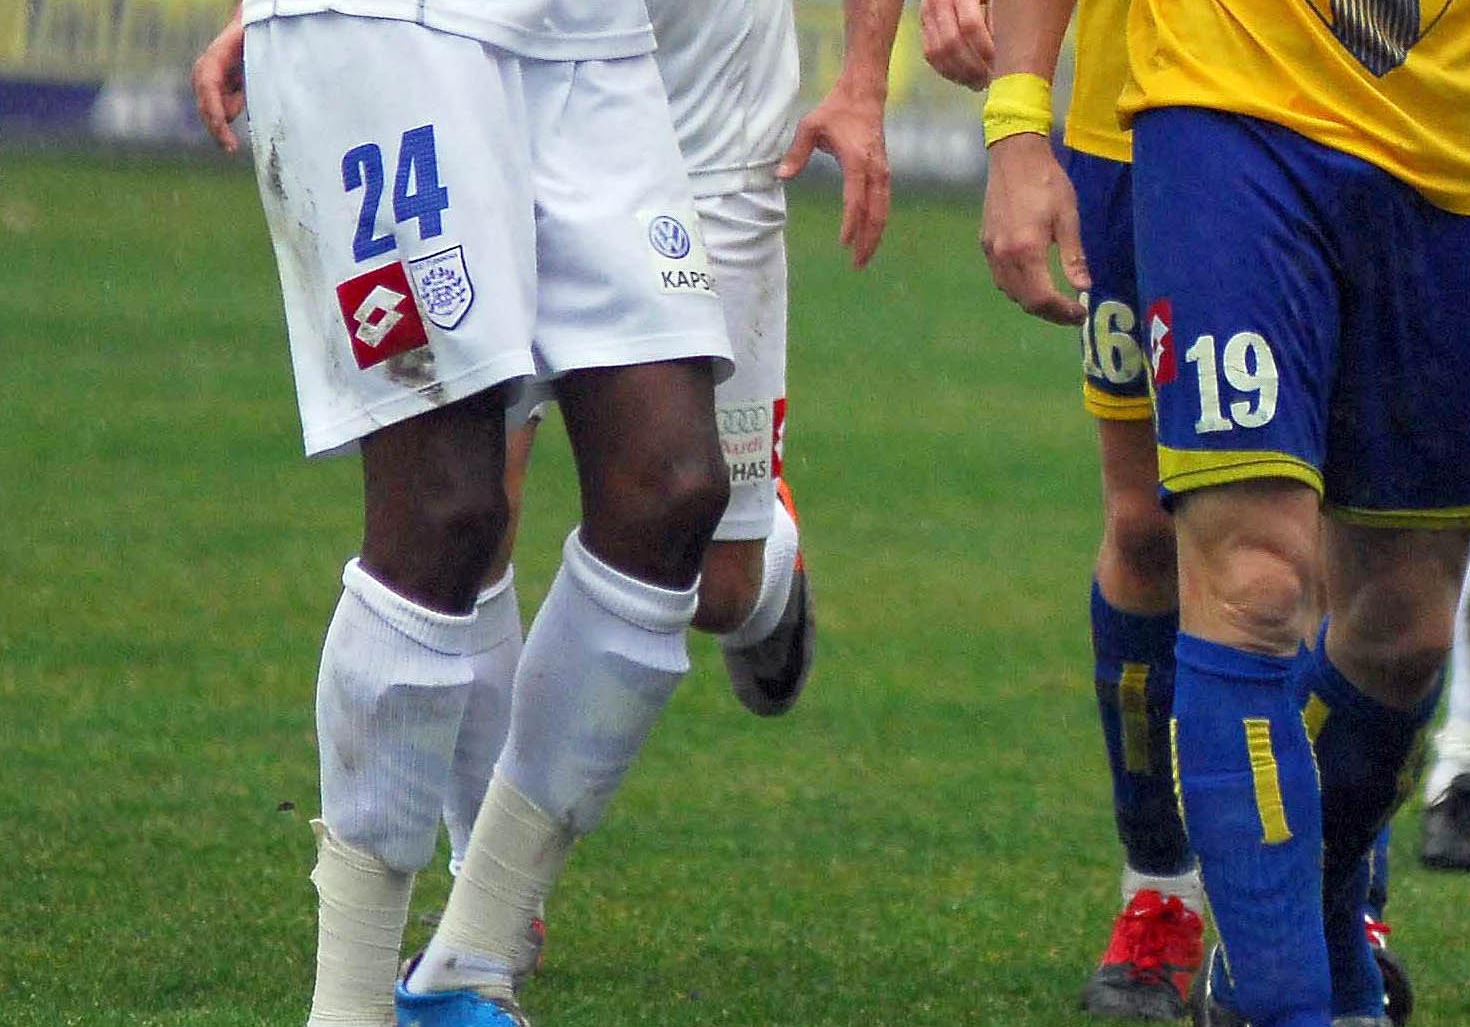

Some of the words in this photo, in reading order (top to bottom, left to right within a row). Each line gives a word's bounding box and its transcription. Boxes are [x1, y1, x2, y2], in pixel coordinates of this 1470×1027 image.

[341, 124, 449, 263] 24
[661, 270, 713, 291] KAPS
[1185, 331, 1280, 435] 19
[731, 460, 767, 482] HAS
